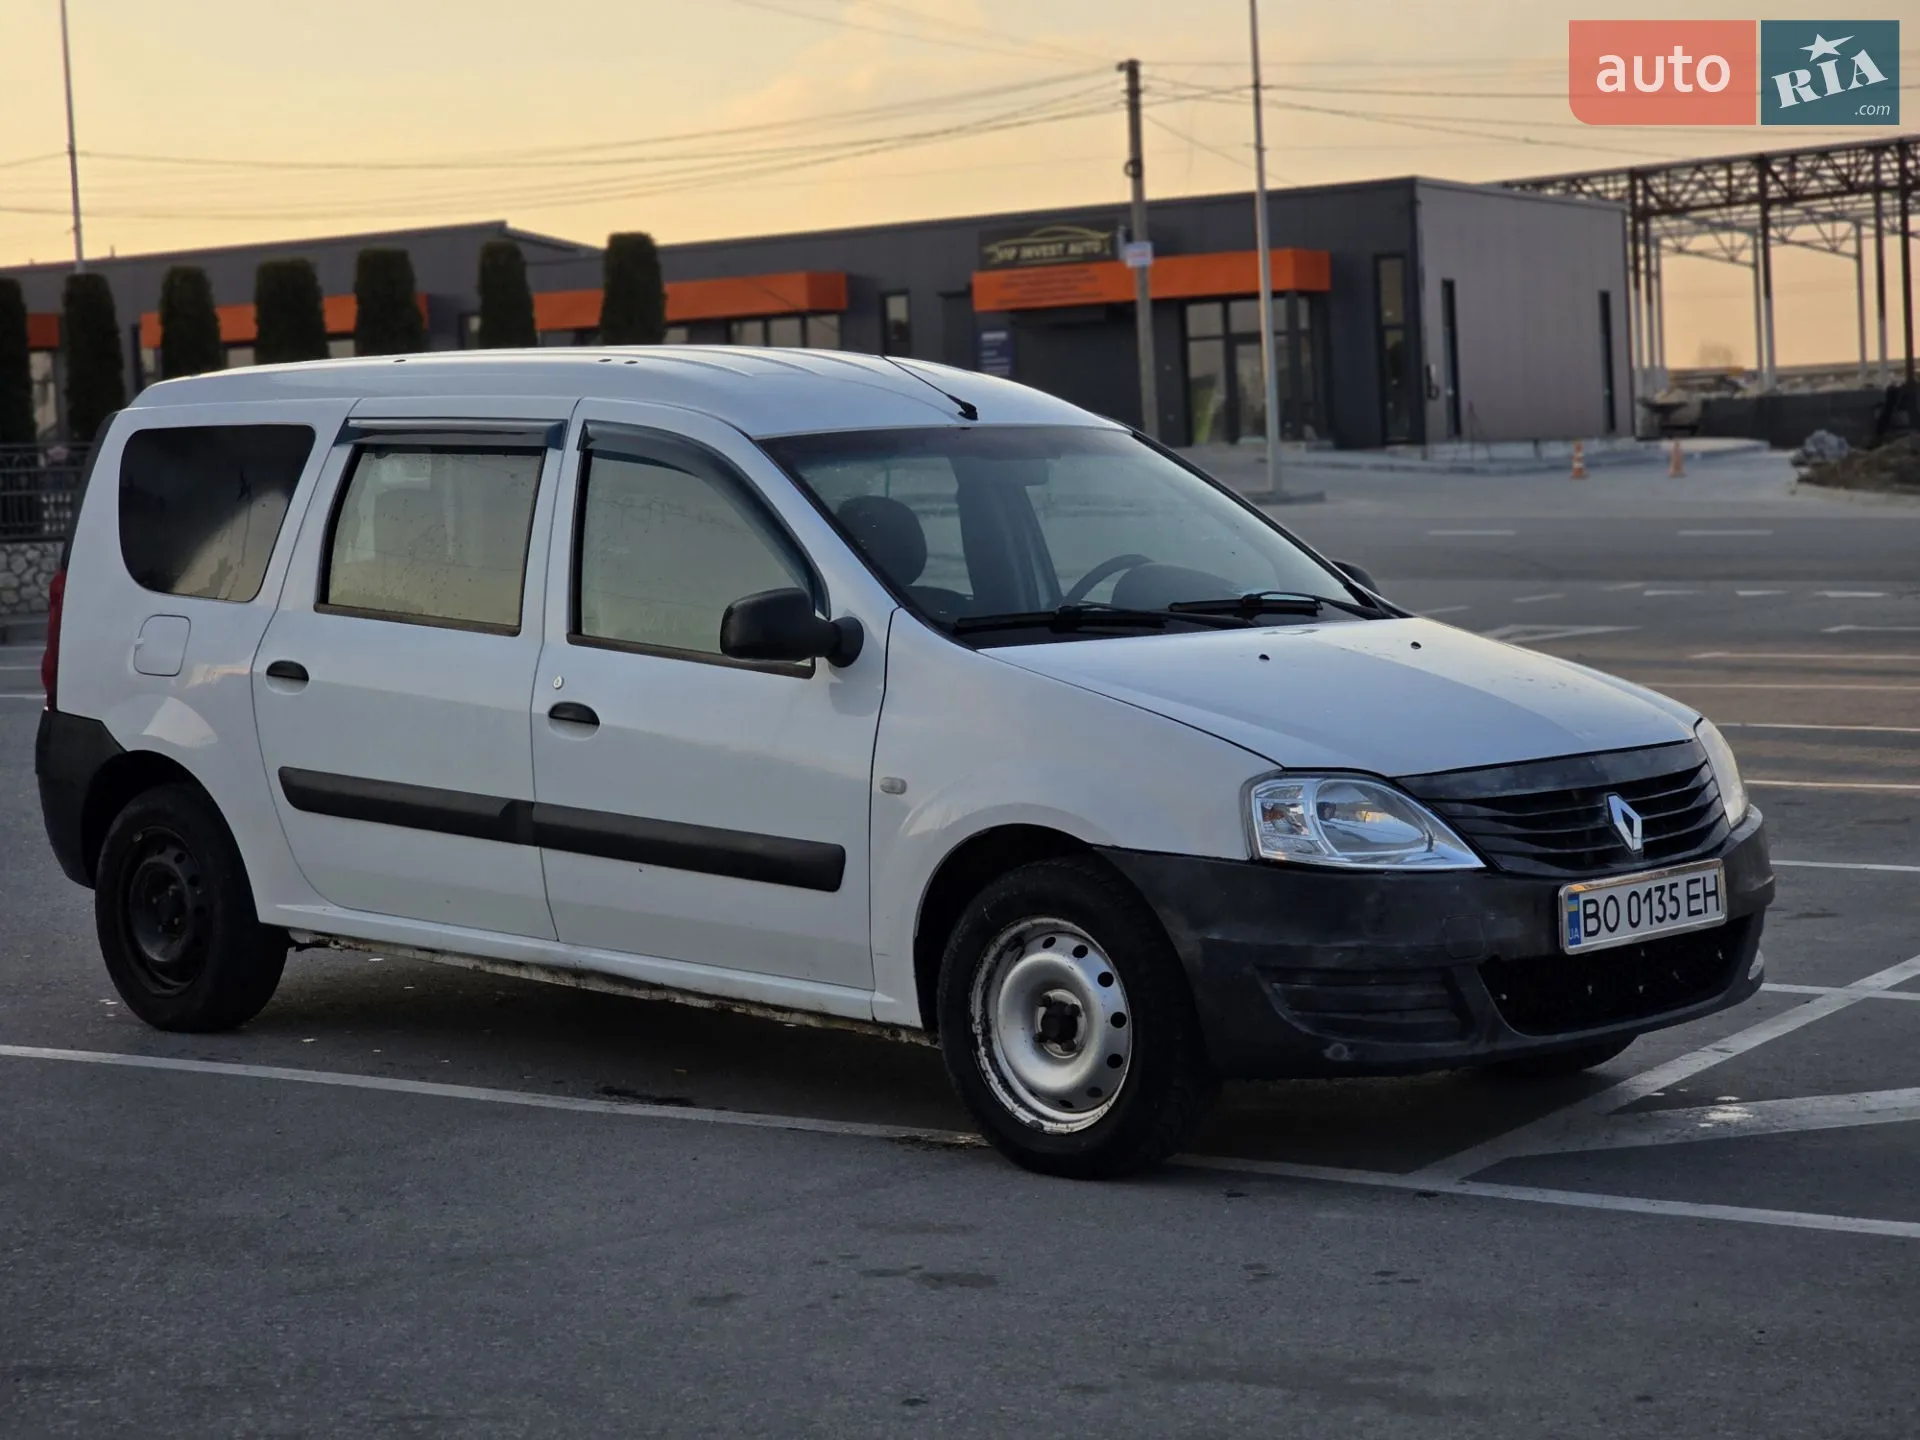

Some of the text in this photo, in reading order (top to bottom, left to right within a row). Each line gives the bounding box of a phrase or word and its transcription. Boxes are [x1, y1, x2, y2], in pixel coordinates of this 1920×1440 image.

[1020, 243, 1064, 259] INVEST
[1069, 240, 1102, 255] AUTO
[1582, 874, 1720, 938] BO 0135 EH
[1568, 929, 1580, 940] UA
